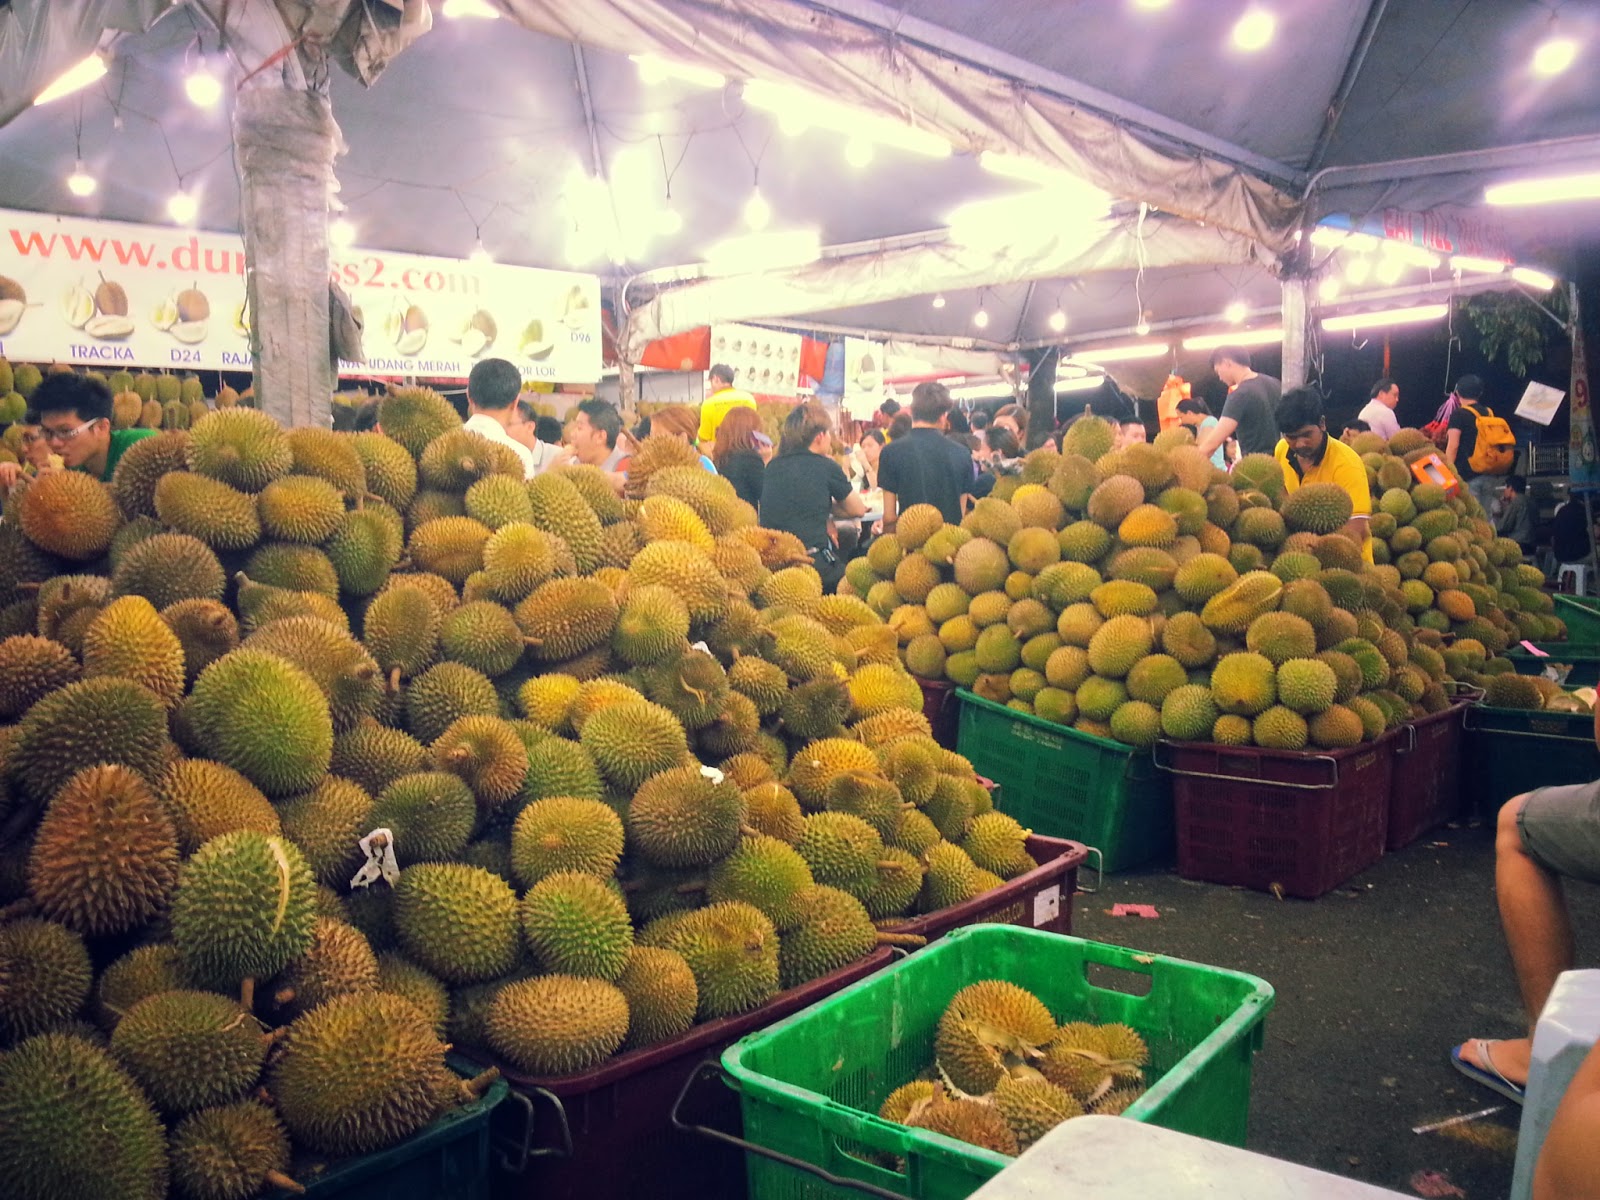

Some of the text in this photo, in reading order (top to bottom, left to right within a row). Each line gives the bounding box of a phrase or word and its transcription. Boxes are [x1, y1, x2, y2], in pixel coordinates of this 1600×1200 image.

[9, 229, 480, 295] www.durss2.com
[570, 331, 591, 344] D96
[70, 344, 135, 361] TRACKA
[170, 348, 201, 363] D24
[369, 358, 413, 371] UDANG
[418, 360, 460, 373] MERAH
